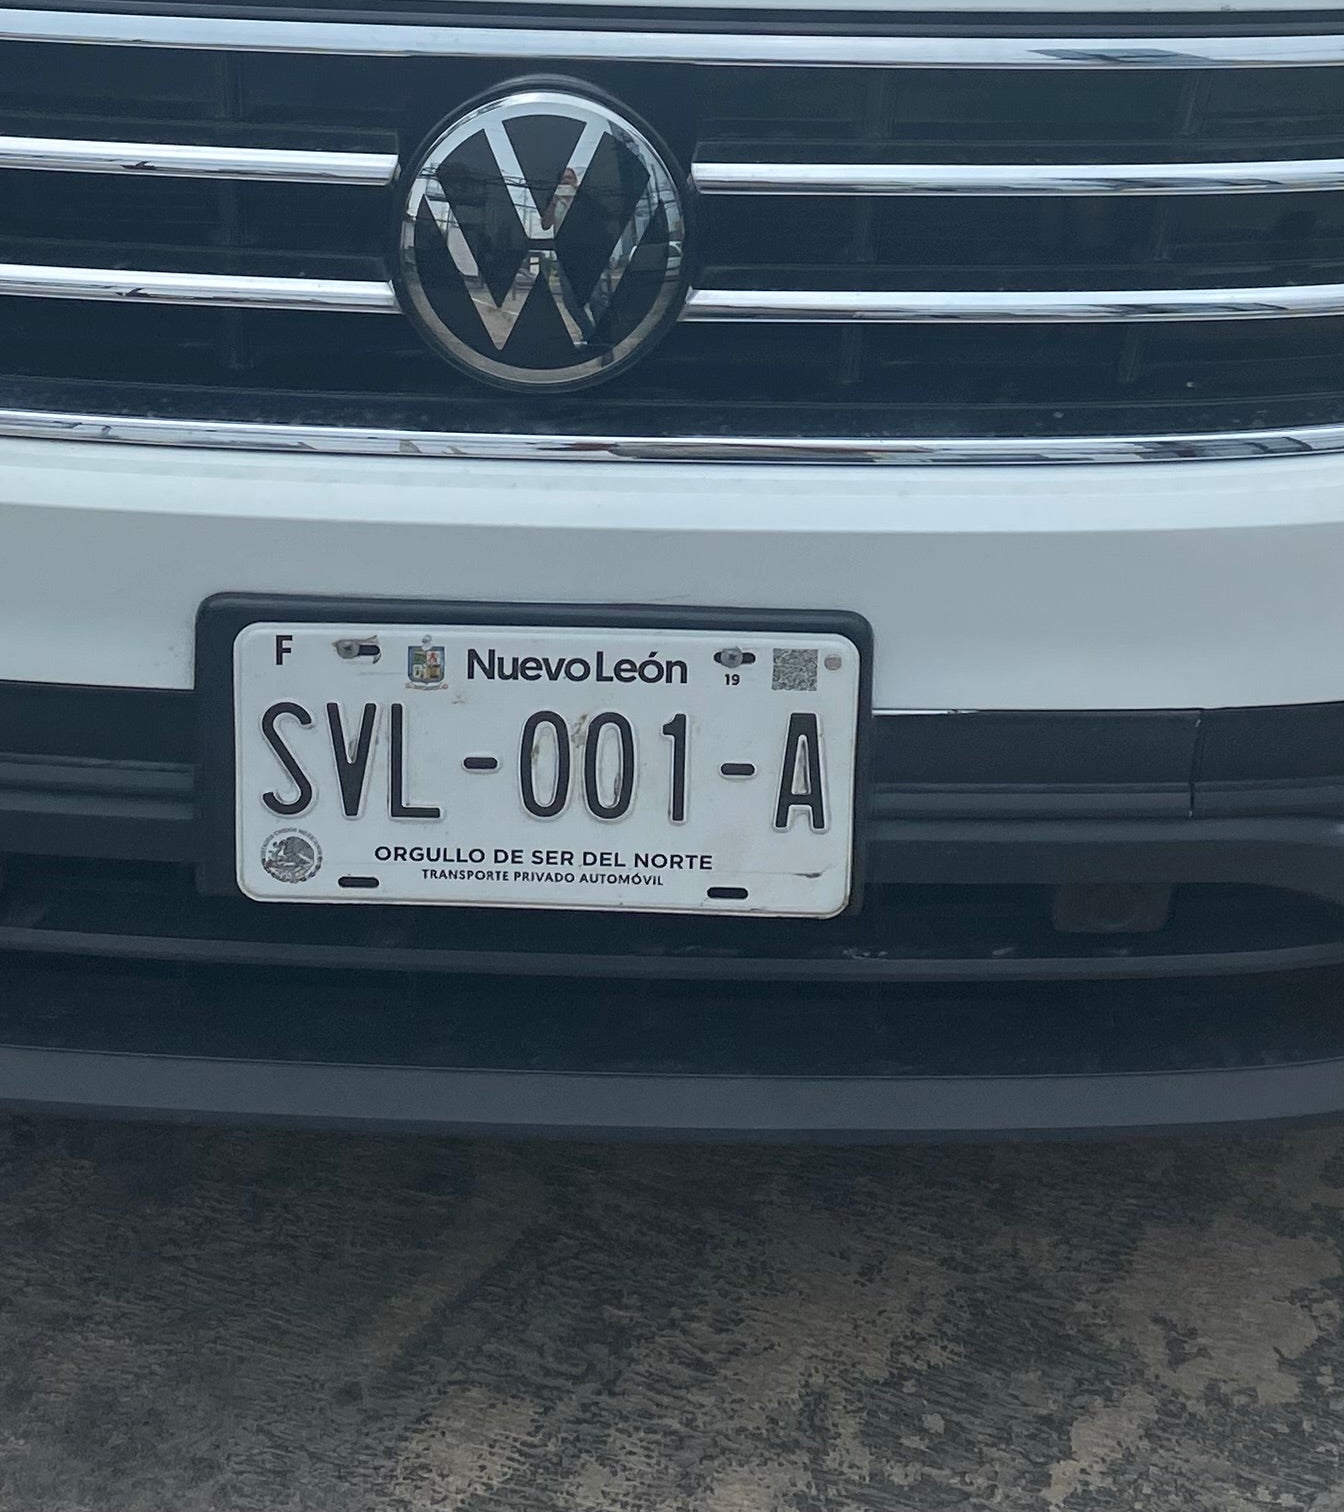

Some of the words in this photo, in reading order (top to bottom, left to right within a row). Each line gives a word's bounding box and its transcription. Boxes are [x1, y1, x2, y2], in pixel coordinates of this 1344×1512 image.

[275, 635, 293, 665] F
[467, 649, 590, 682] Nuevo
[596, 651, 688, 684] León
[724, 674, 740, 686] 19
[261, 702, 826, 829] SVL-001-A
[375, 846, 485, 864] ORGULLO
[493, 849, 524, 866] DE
[531, 849, 575, 867] SER
[583, 851, 628, 869] DEL
[634, 852, 713, 870] NORTE
[422, 868, 509, 882] TRANSPORTE
[513, 871, 575, 884] PRIVADO
[579, 871, 664, 887] AUTOMÓVIL
